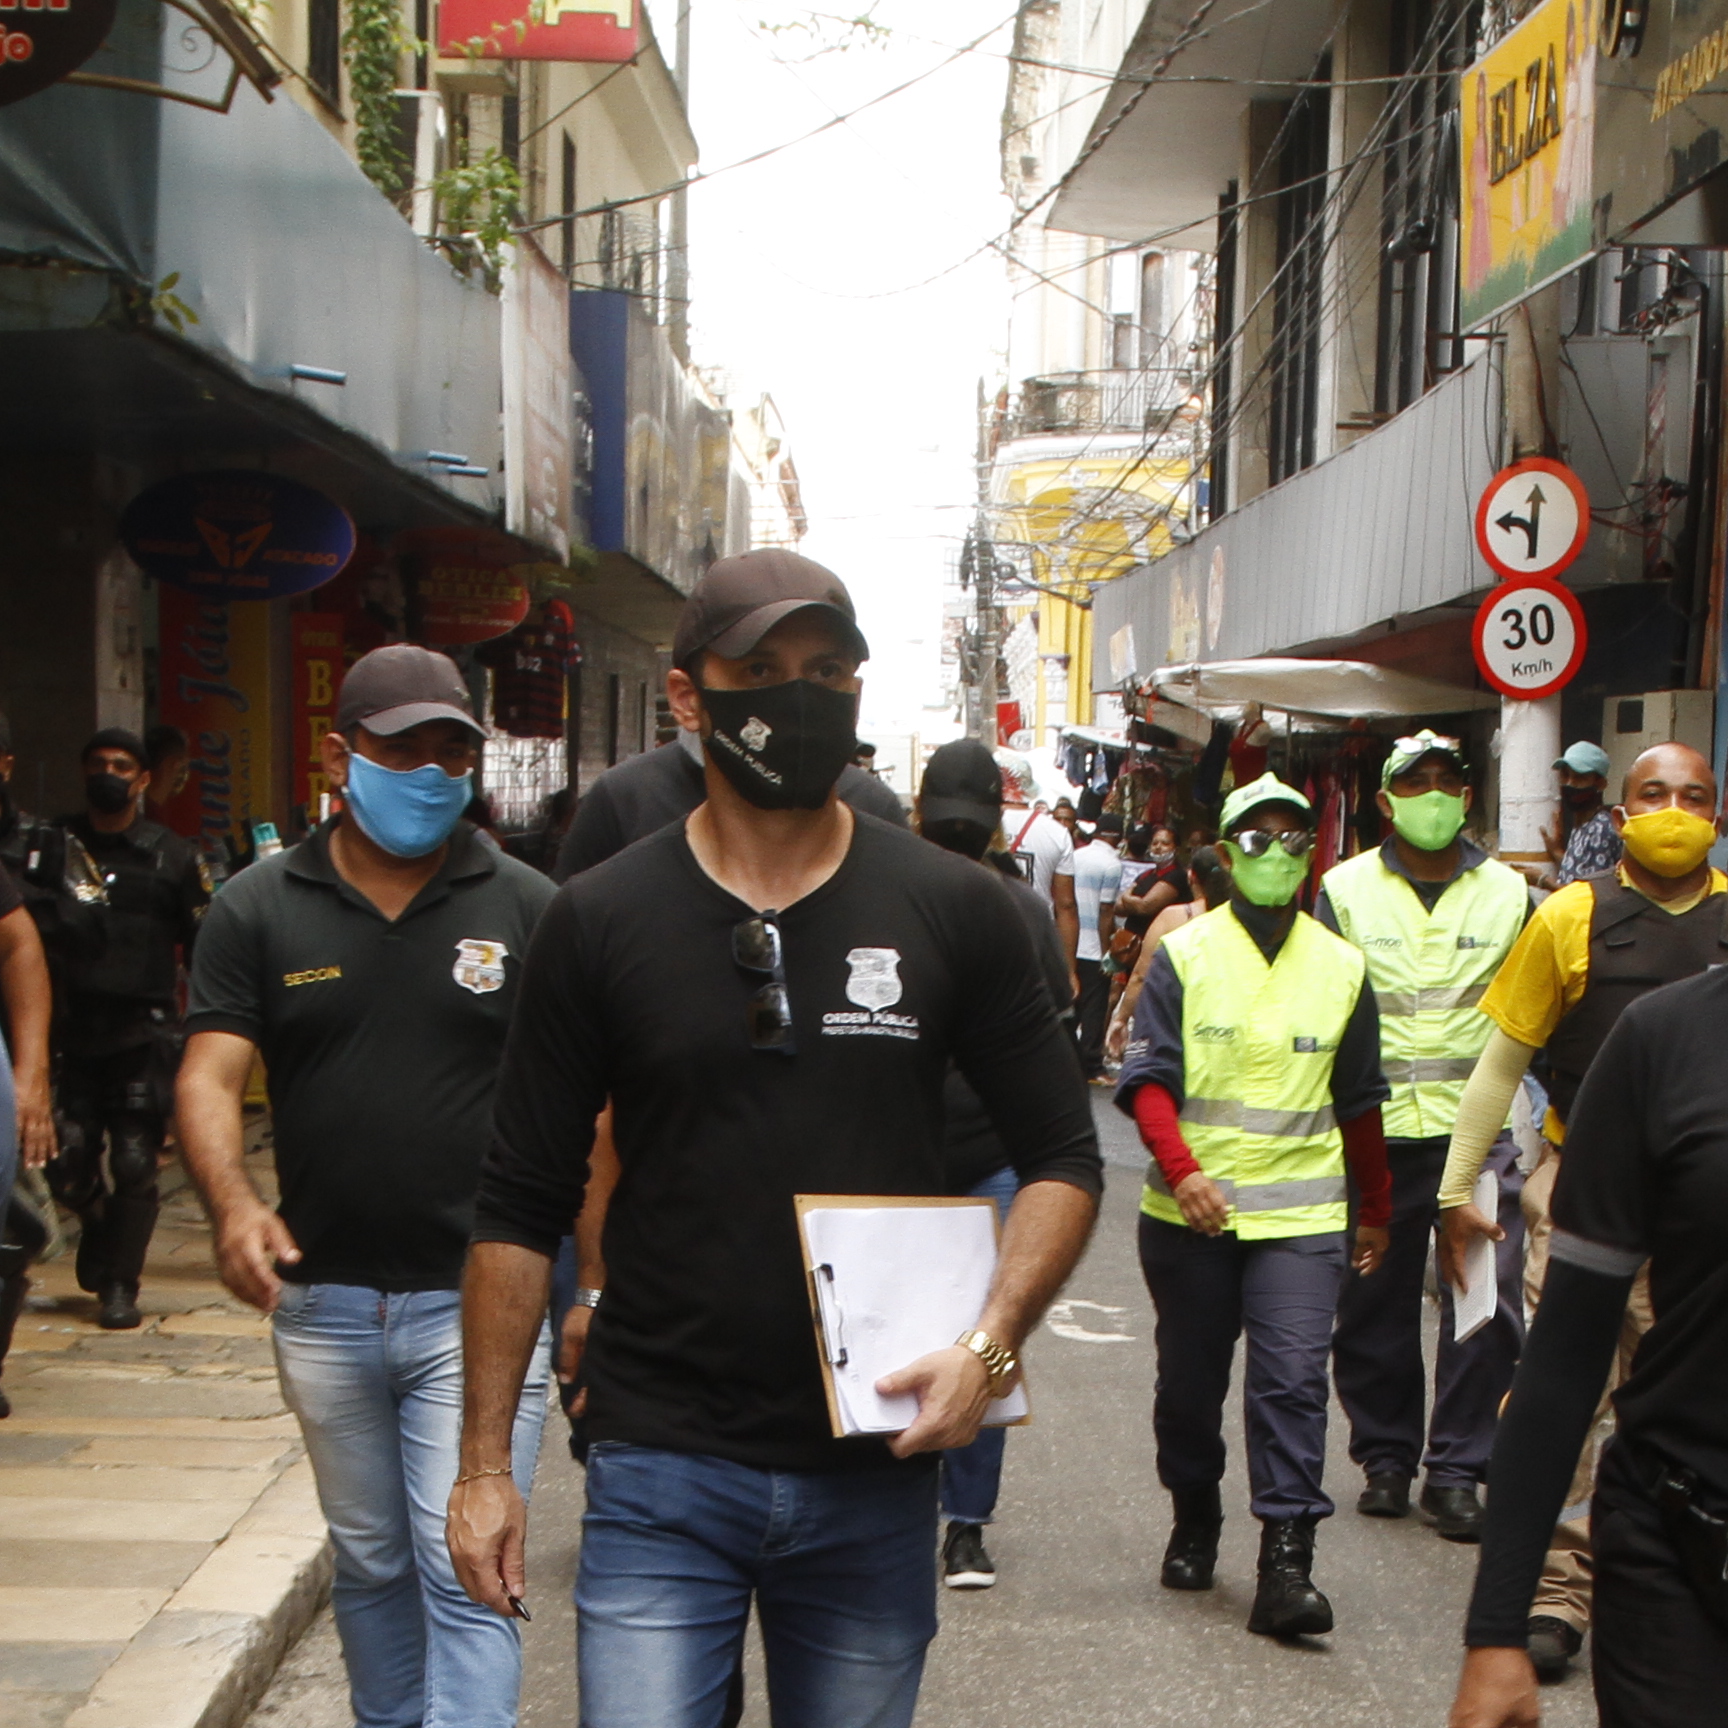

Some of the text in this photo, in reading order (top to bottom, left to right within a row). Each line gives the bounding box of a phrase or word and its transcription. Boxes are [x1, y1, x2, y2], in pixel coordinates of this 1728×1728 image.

[1490, 42, 1561, 187] ELZA
[1500, 603, 1555, 651] 30
[1511, 658, 1553, 677] Km/h
[822, 1010, 919, 1028] ORDEM PÚBLICA
